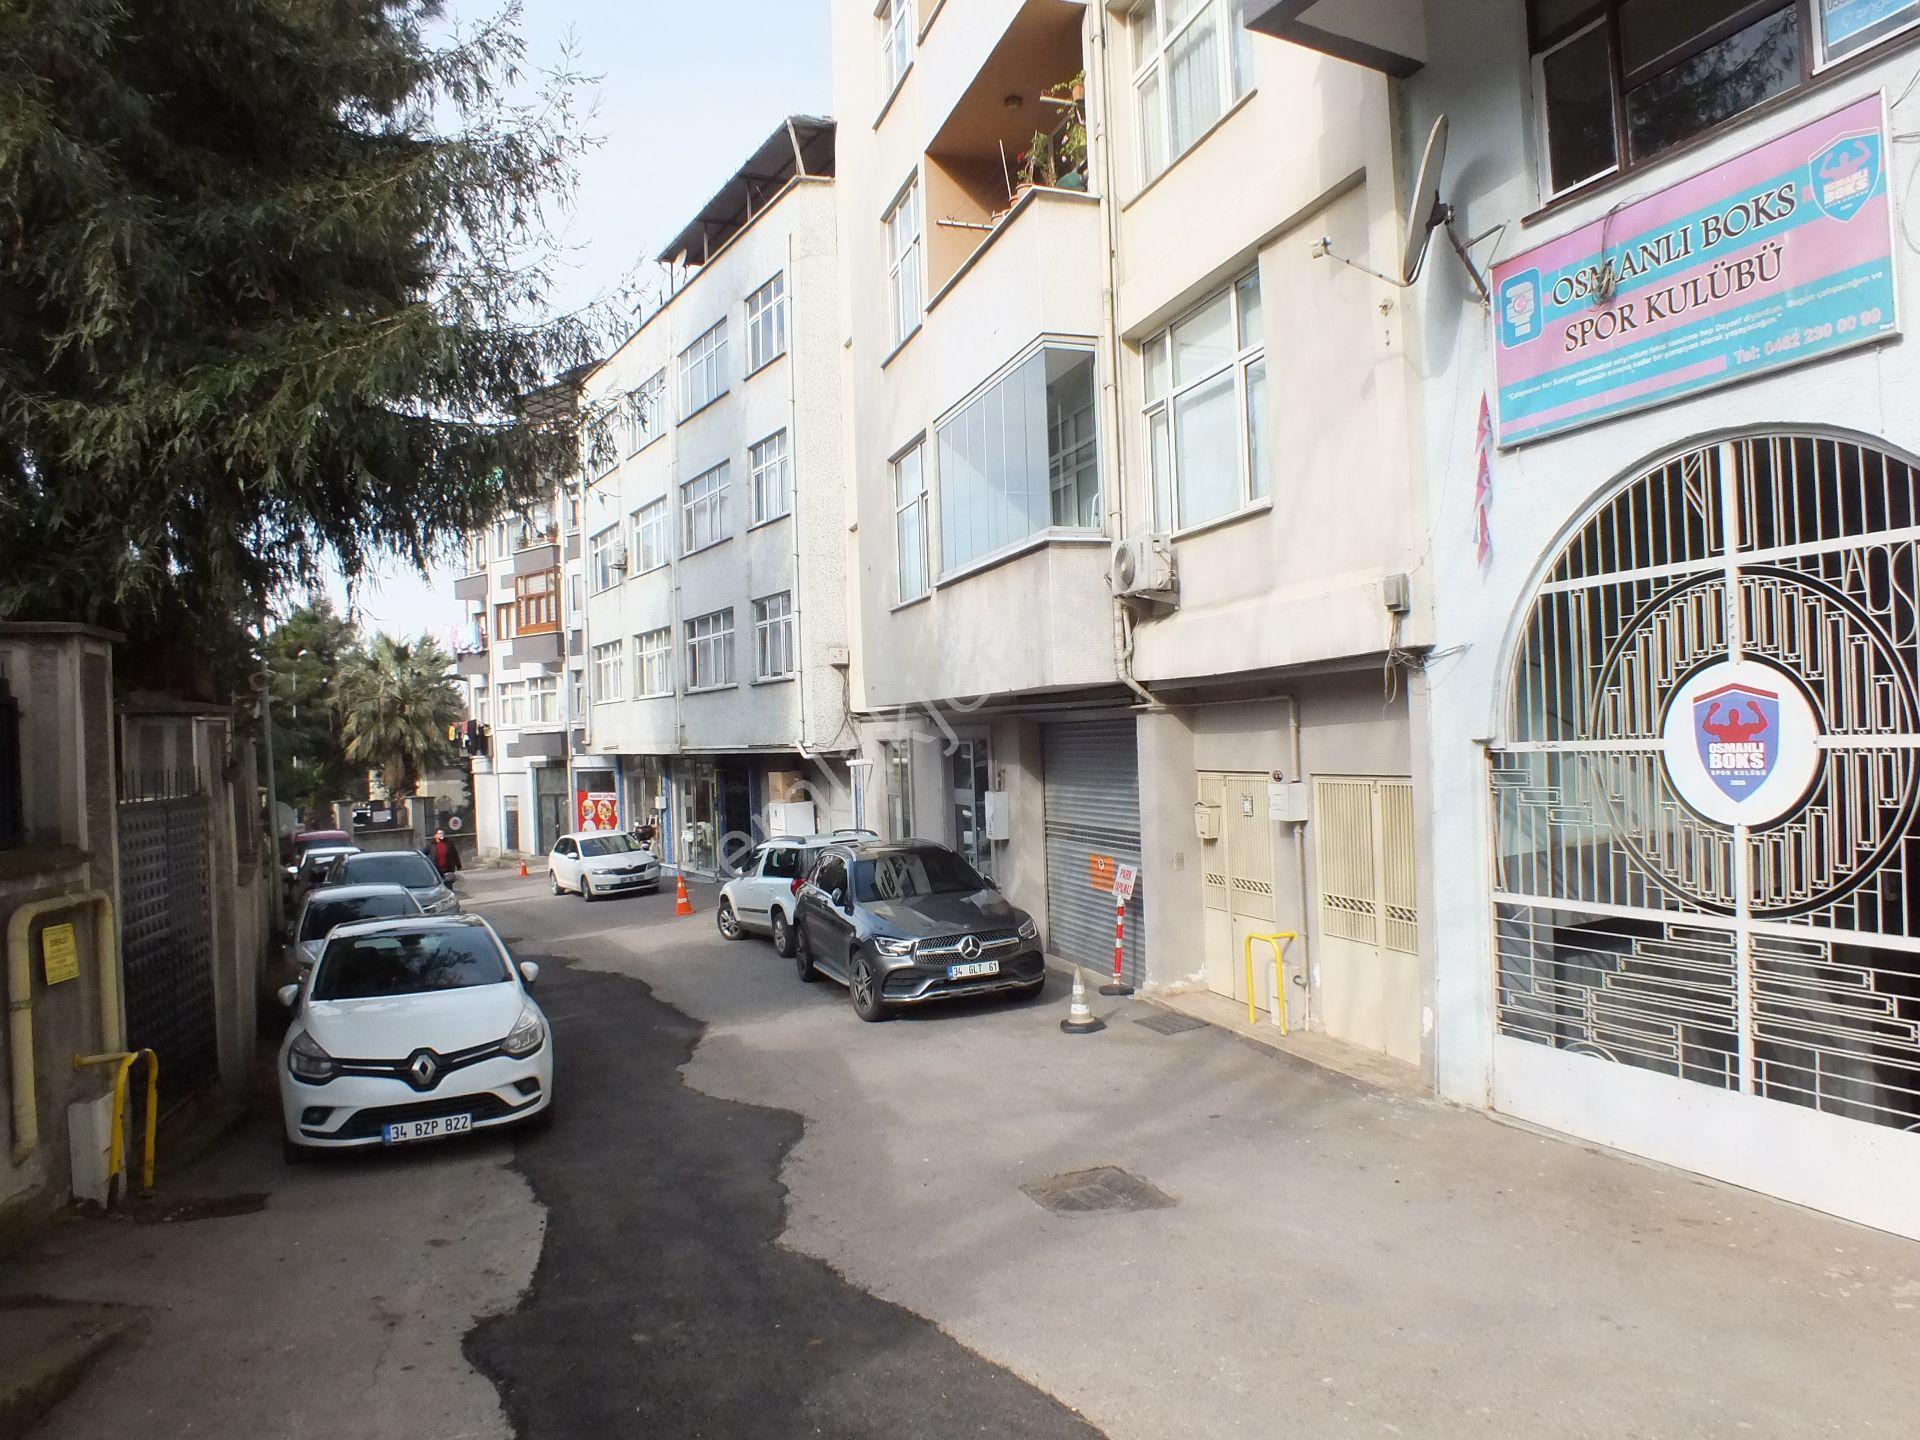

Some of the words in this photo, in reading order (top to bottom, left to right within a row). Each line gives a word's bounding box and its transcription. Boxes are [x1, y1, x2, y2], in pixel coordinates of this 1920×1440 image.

[1553, 225, 1692, 306] OSMANLI
[1702, 184, 1795, 248] BOKS
[1565, 303, 1637, 352] SPOR
[1644, 242, 1783, 324] KULÜBÜ
[1734, 345, 1760, 364] Tel:
[1708, 742, 1765, 754] OSMANLI
[1709, 752, 1765, 769] BOKS
[953, 965, 963, 977] 34
[391, 1125, 408, 1140] 34
[415, 1120, 439, 1137] BZP
[445, 1115, 469, 1132] 822
